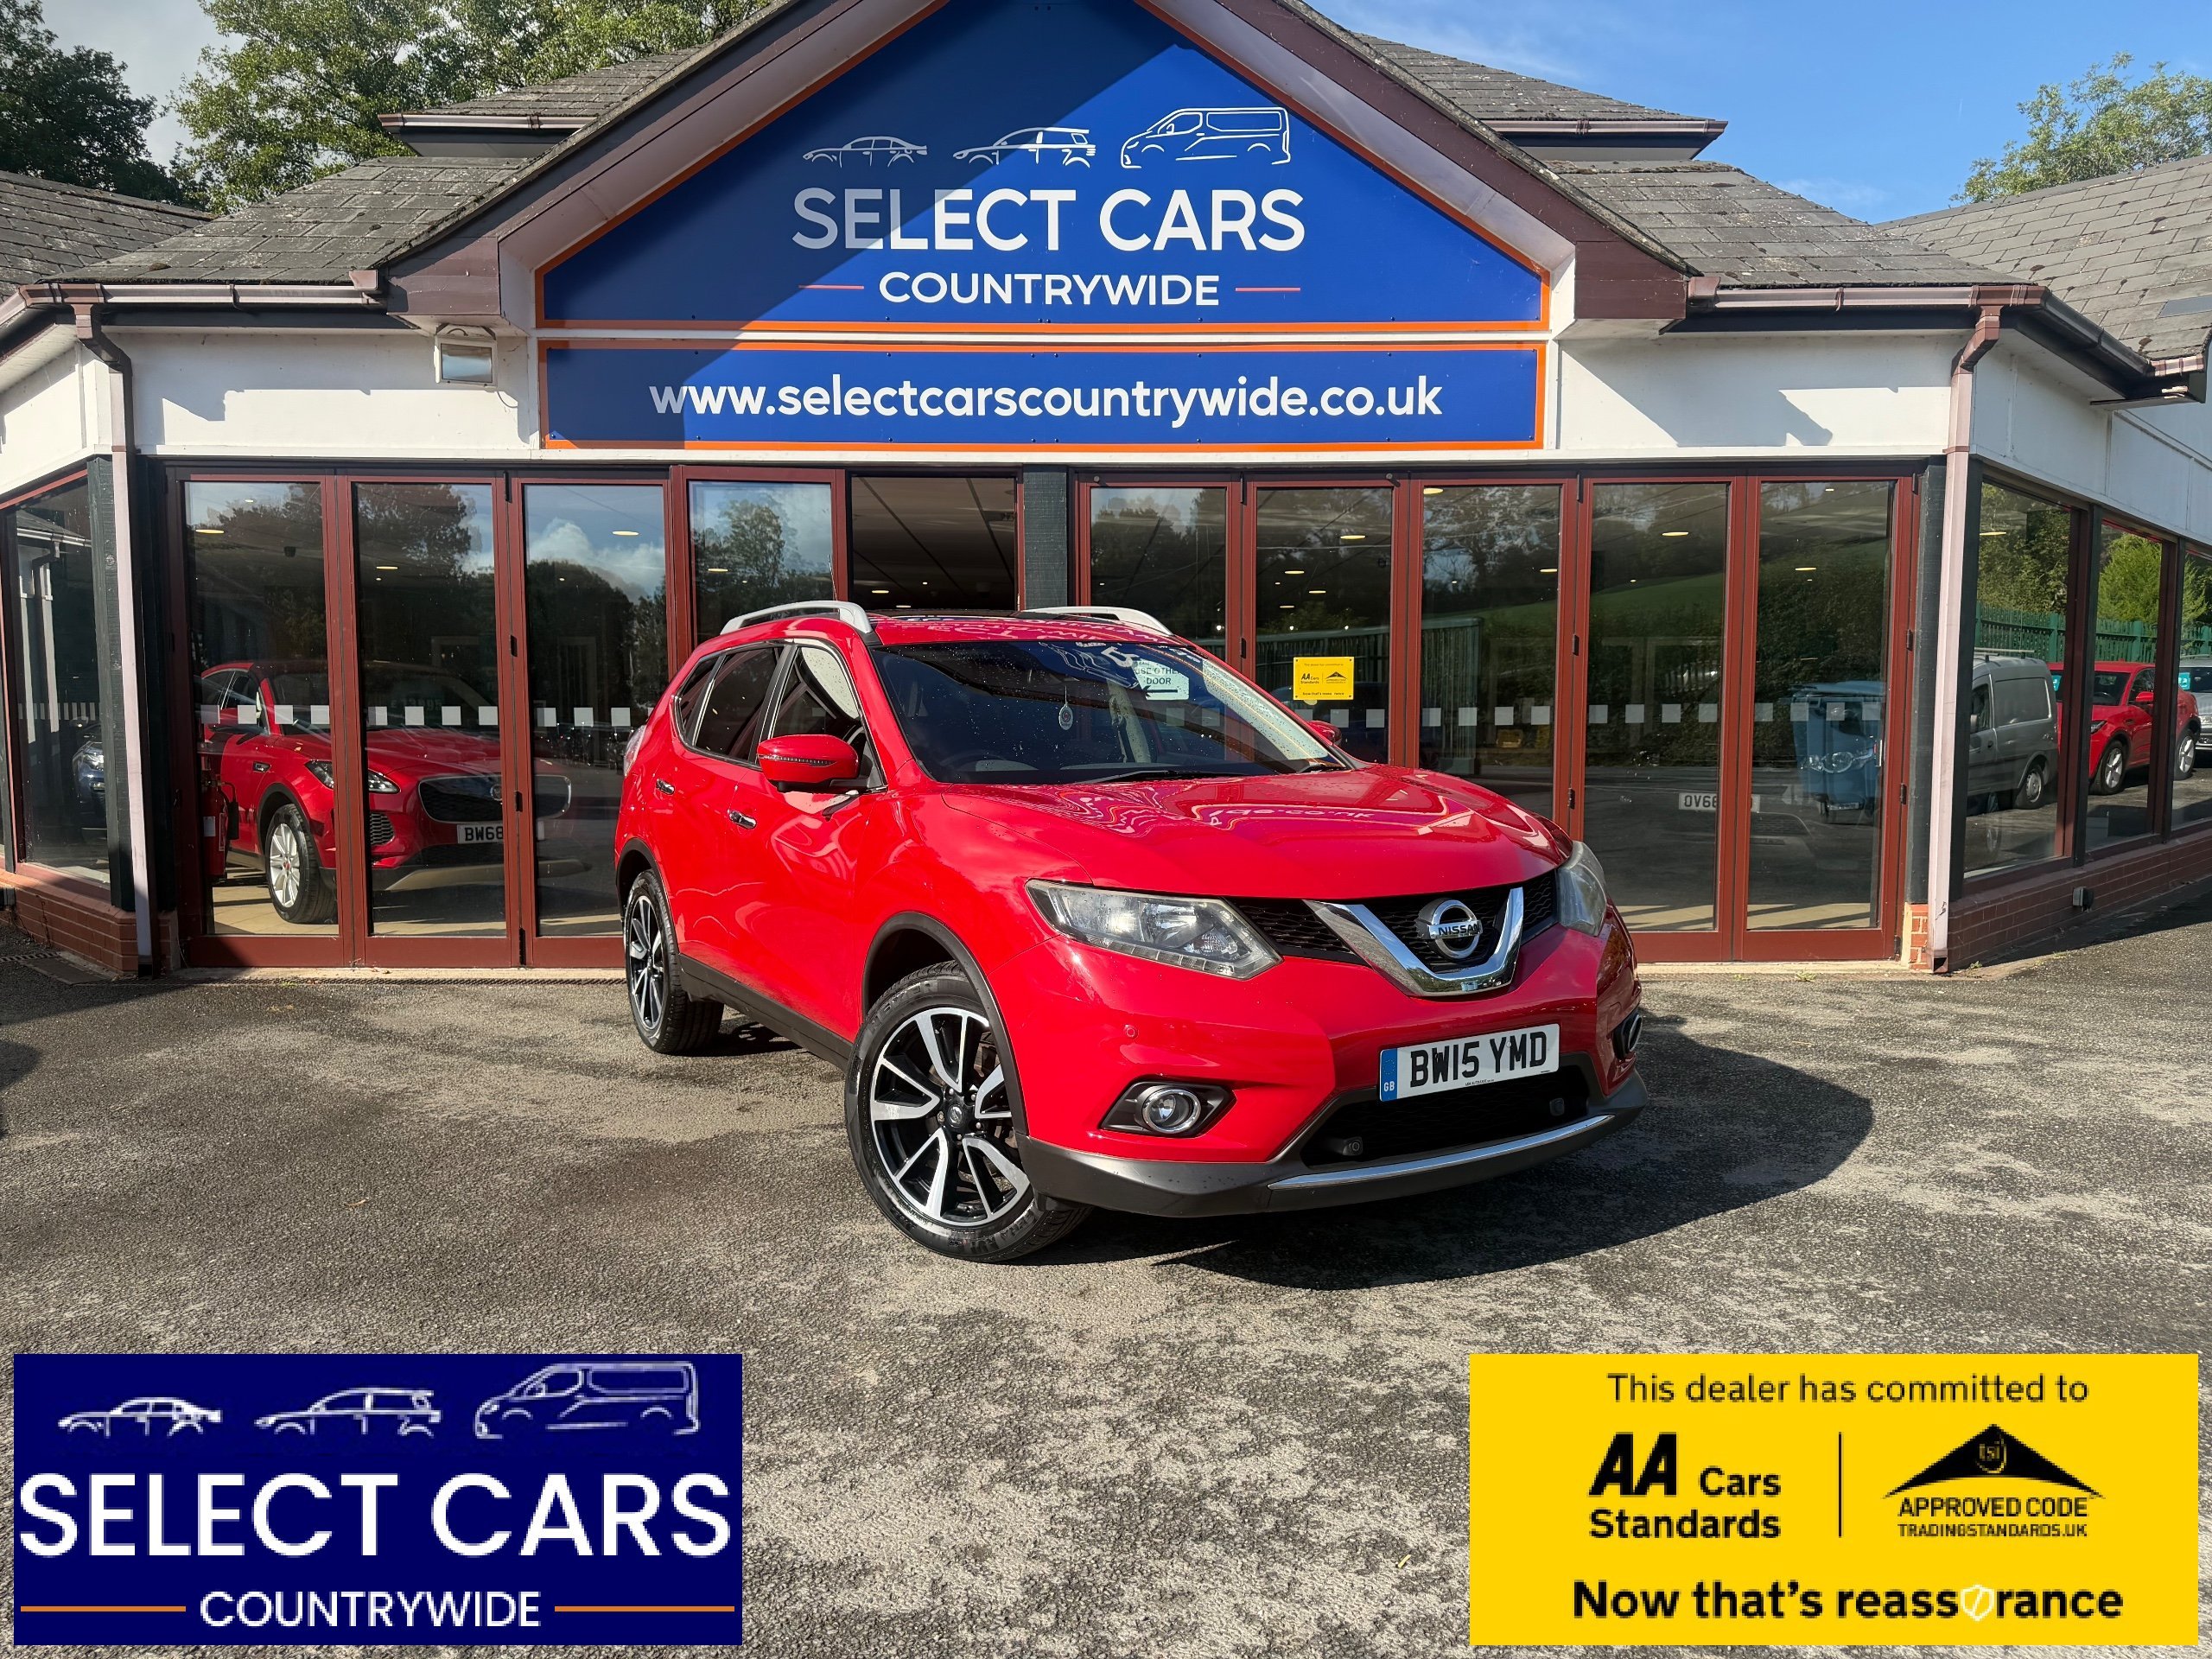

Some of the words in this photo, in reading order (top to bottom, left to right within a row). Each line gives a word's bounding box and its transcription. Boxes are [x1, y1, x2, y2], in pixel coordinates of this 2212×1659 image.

[792, 188, 1077, 251] SELECT
[1100, 189, 1306, 252] CARS
[880, 272, 1220, 306] COUNTRYWIDE
[649, 374, 1443, 429] www.selectcarscountrywide.co.uk
[1146, 677, 1172, 685] DOOR
[465, 826, 503, 842] BW68
[1438, 923, 1480, 936] NISSAN
[1410, 1040, 1480, 1088] BW15
[1490, 1031, 1548, 1074] YMD
[1383, 1081, 1395, 1092] GB
